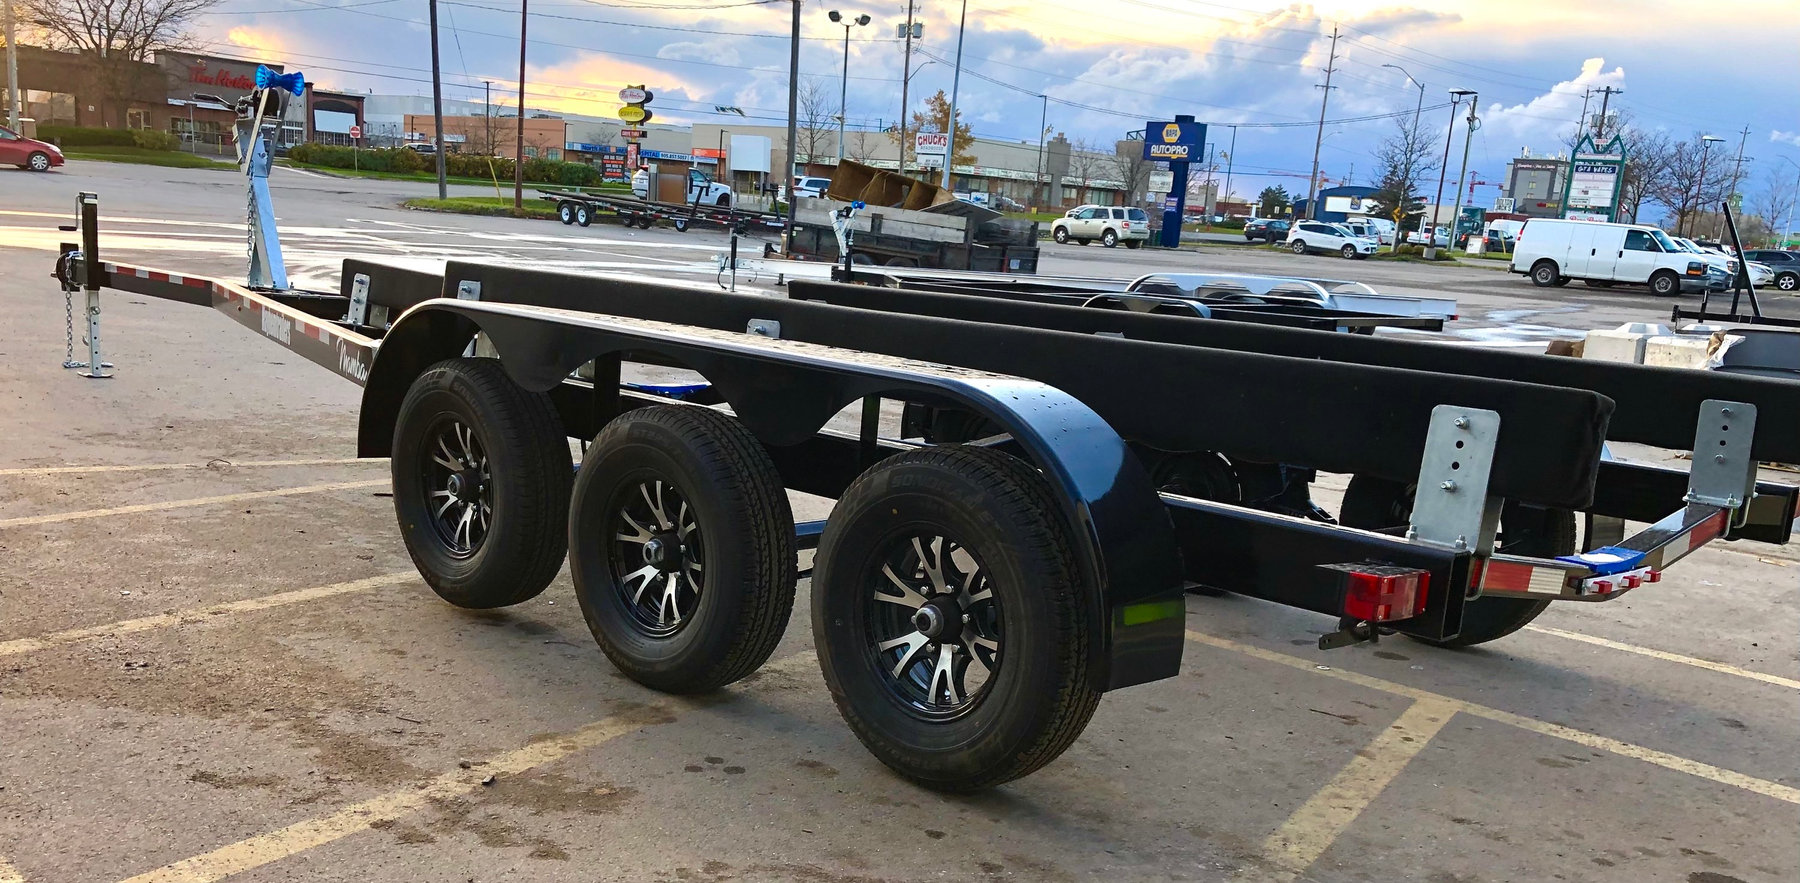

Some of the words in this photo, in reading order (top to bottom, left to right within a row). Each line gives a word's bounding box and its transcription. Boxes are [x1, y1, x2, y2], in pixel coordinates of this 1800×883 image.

[190, 66, 214, 86] Tim
[215, 68, 257, 90] Horton
[917, 134, 947, 147] CHUCK'S
[1151, 144, 1189, 154] AUTOPRO
